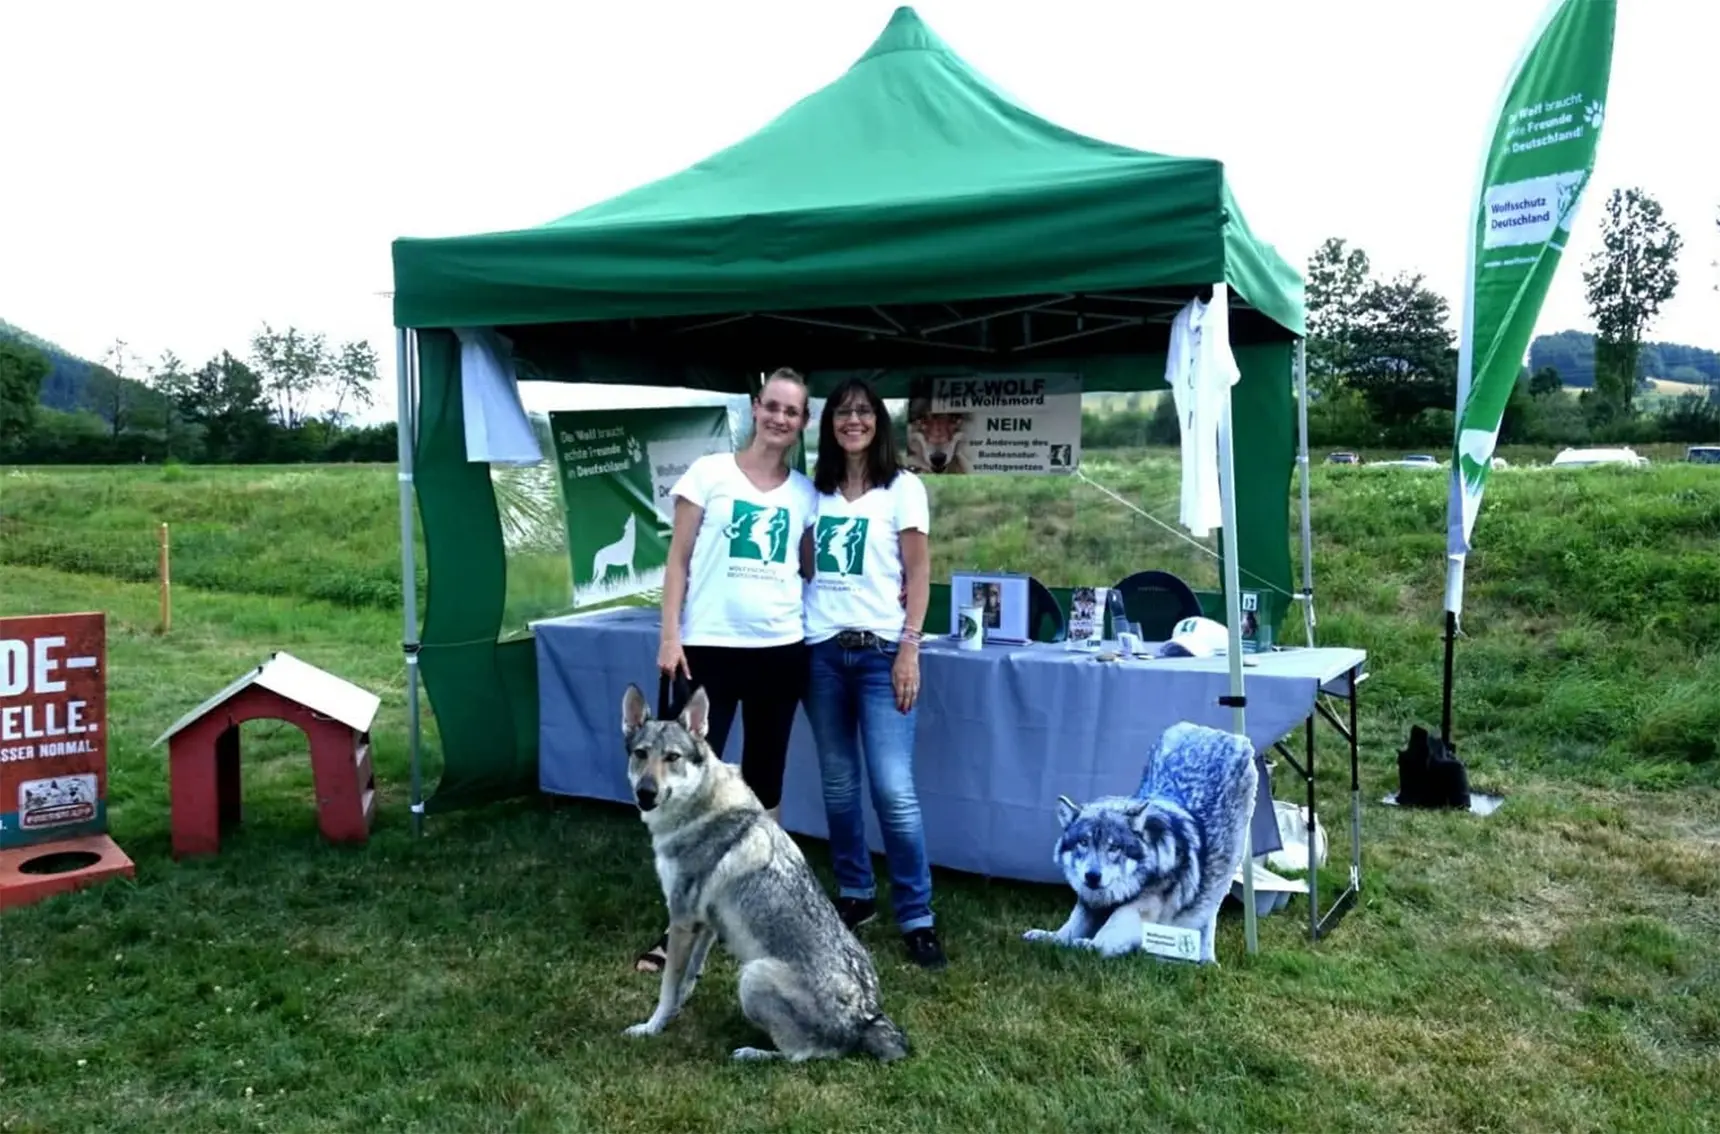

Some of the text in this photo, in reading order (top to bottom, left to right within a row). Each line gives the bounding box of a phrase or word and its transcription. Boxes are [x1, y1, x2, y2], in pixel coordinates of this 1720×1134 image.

[1527, 113, 1573, 133] Freunde
[1491, 196, 1546, 214] Wolfsschutz
[1491, 210, 1550, 229] Deutschland
[971, 395, 1045, 407] Wolfsmord
[986, 418, 1032, 431] NEIN
[2, 700, 98, 740] ELLE.
